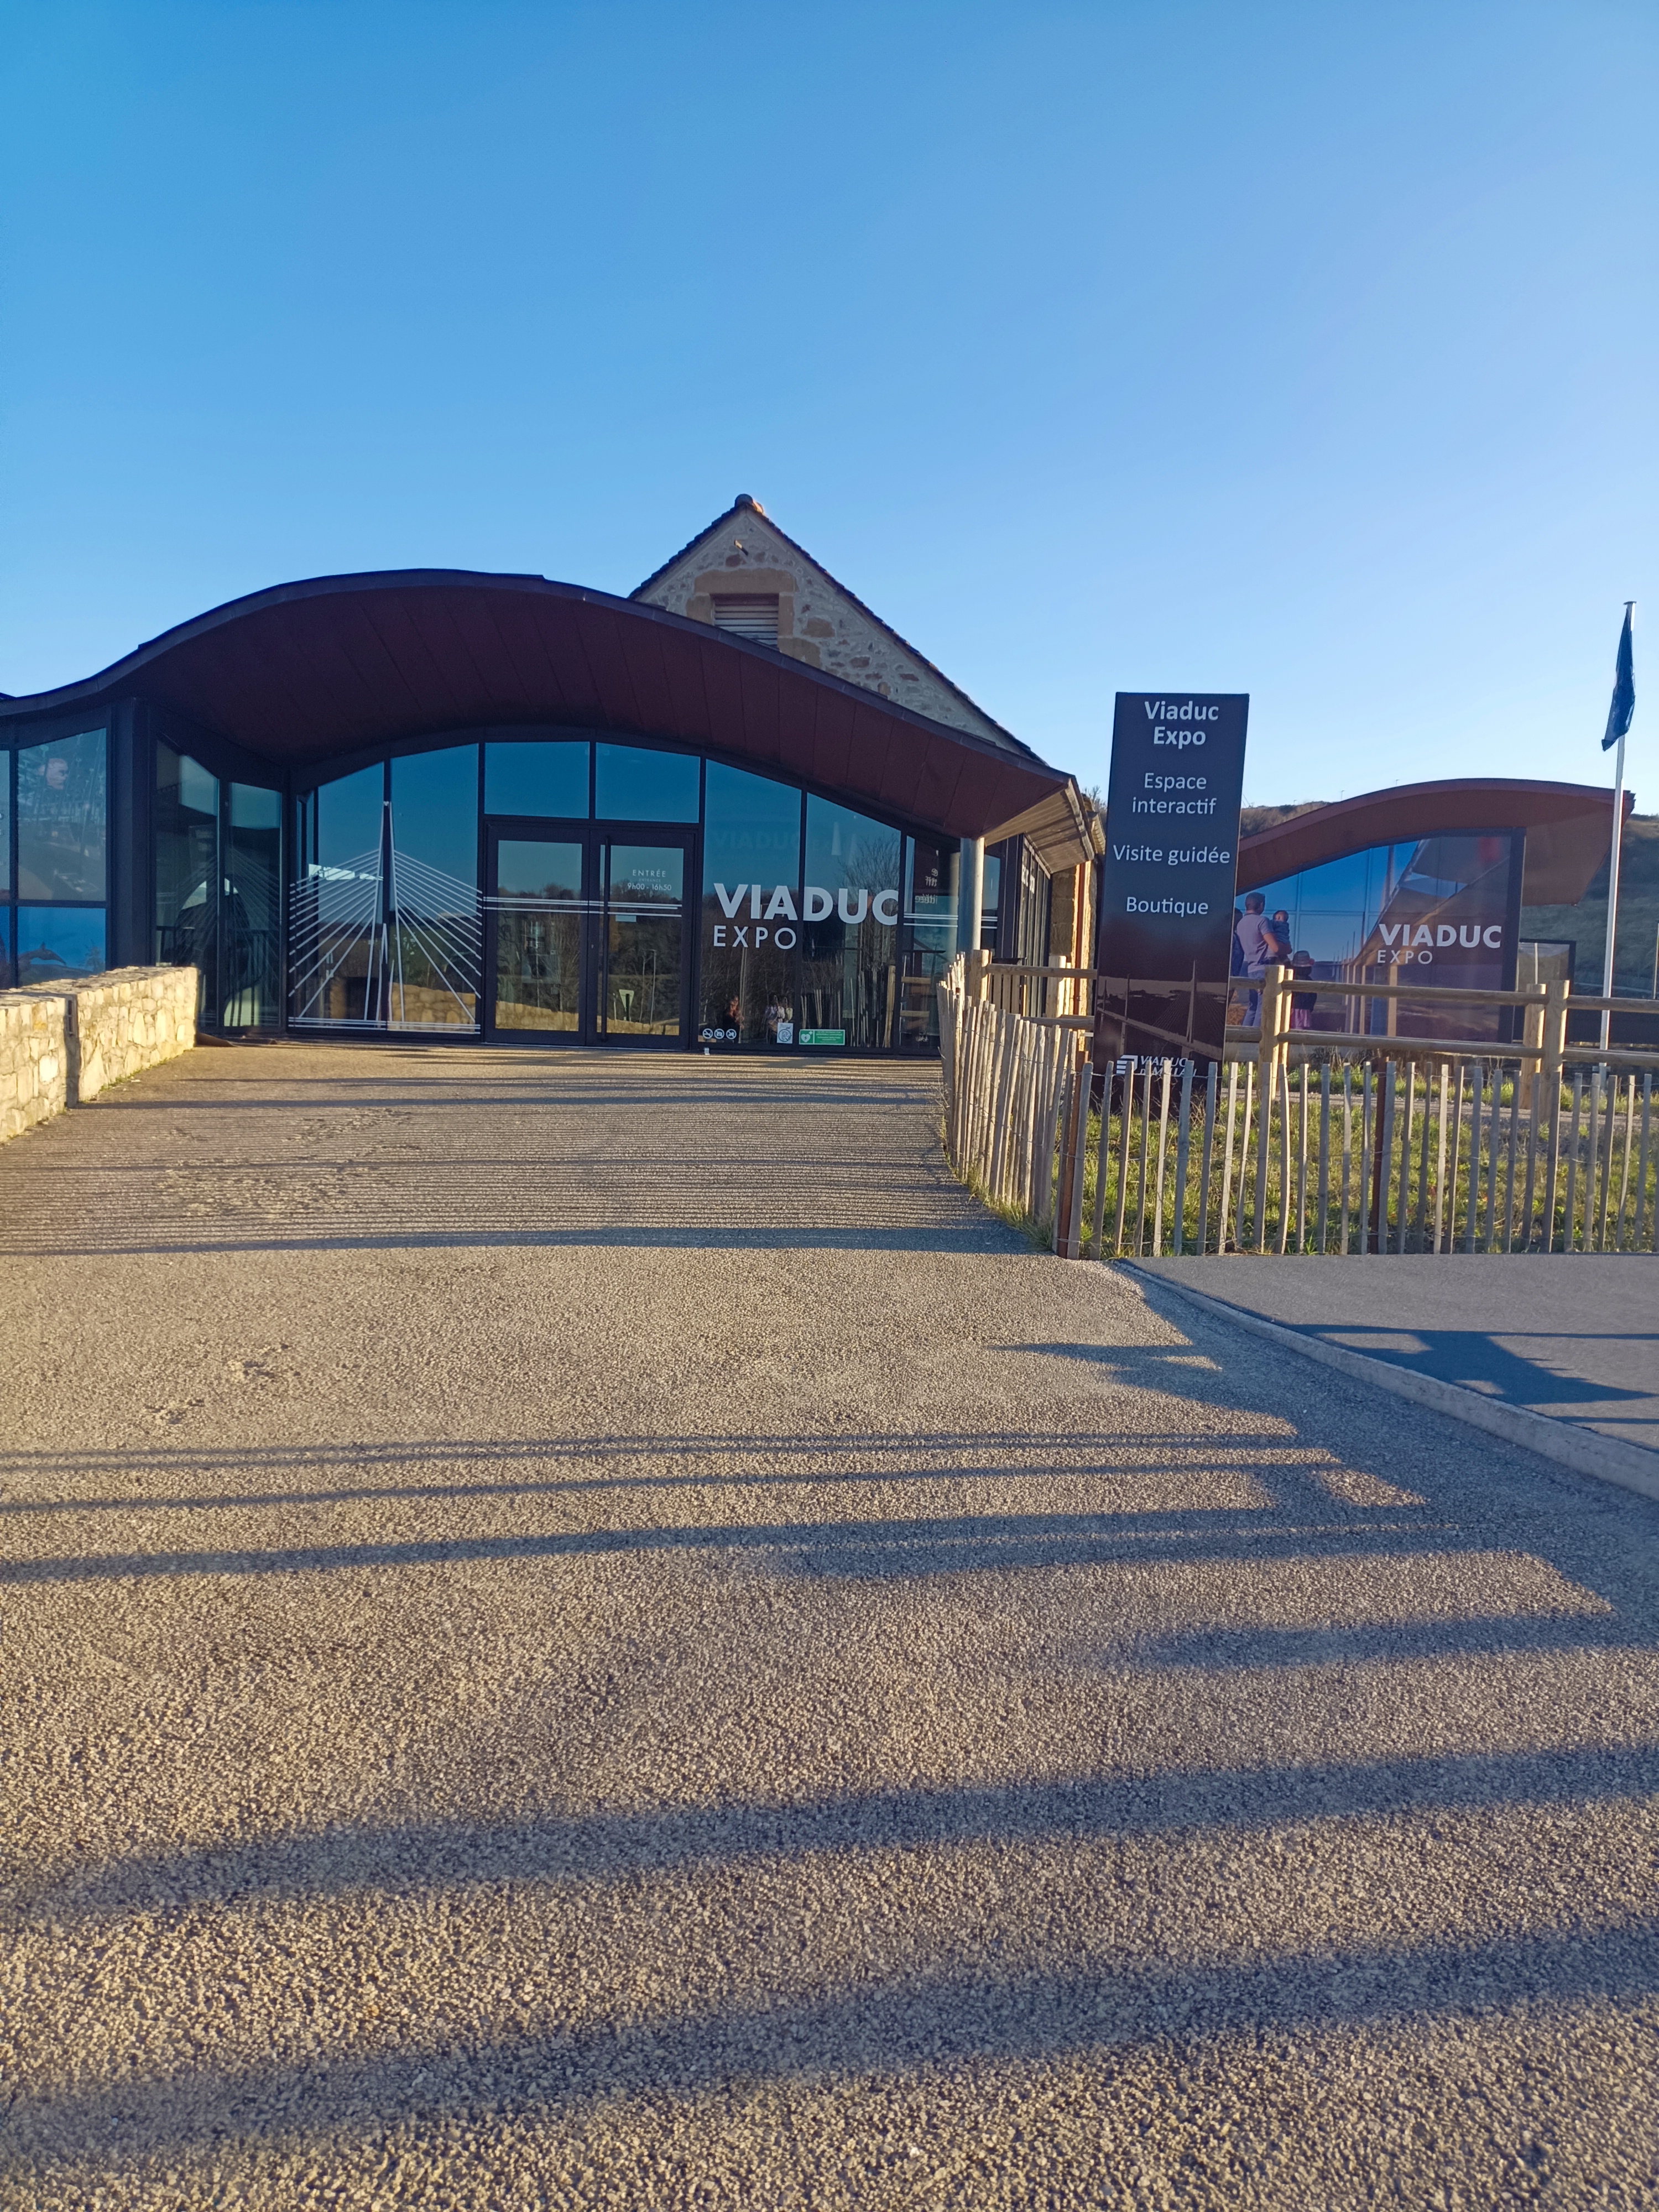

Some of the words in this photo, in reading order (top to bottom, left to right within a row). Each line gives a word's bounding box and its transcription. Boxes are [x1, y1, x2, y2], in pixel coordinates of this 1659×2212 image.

[1145, 701, 1219, 720] Viaduc
[1154, 727, 1206, 749] Expo
[1144, 773, 1207, 792] Espace
[1133, 797, 1217, 815] interactif
[1113, 844, 1163, 862] Visite
[1167, 847, 1230, 865] guidée
[632, 869, 666, 877] ENTRÉE
[713, 883, 899, 926] VIADUC
[1126, 896, 1208, 917] Boutique
[713, 925, 796, 950] EXPO
[1379, 924, 1502, 948] VIADUC
[1378, 950, 1433, 964] EXPO
